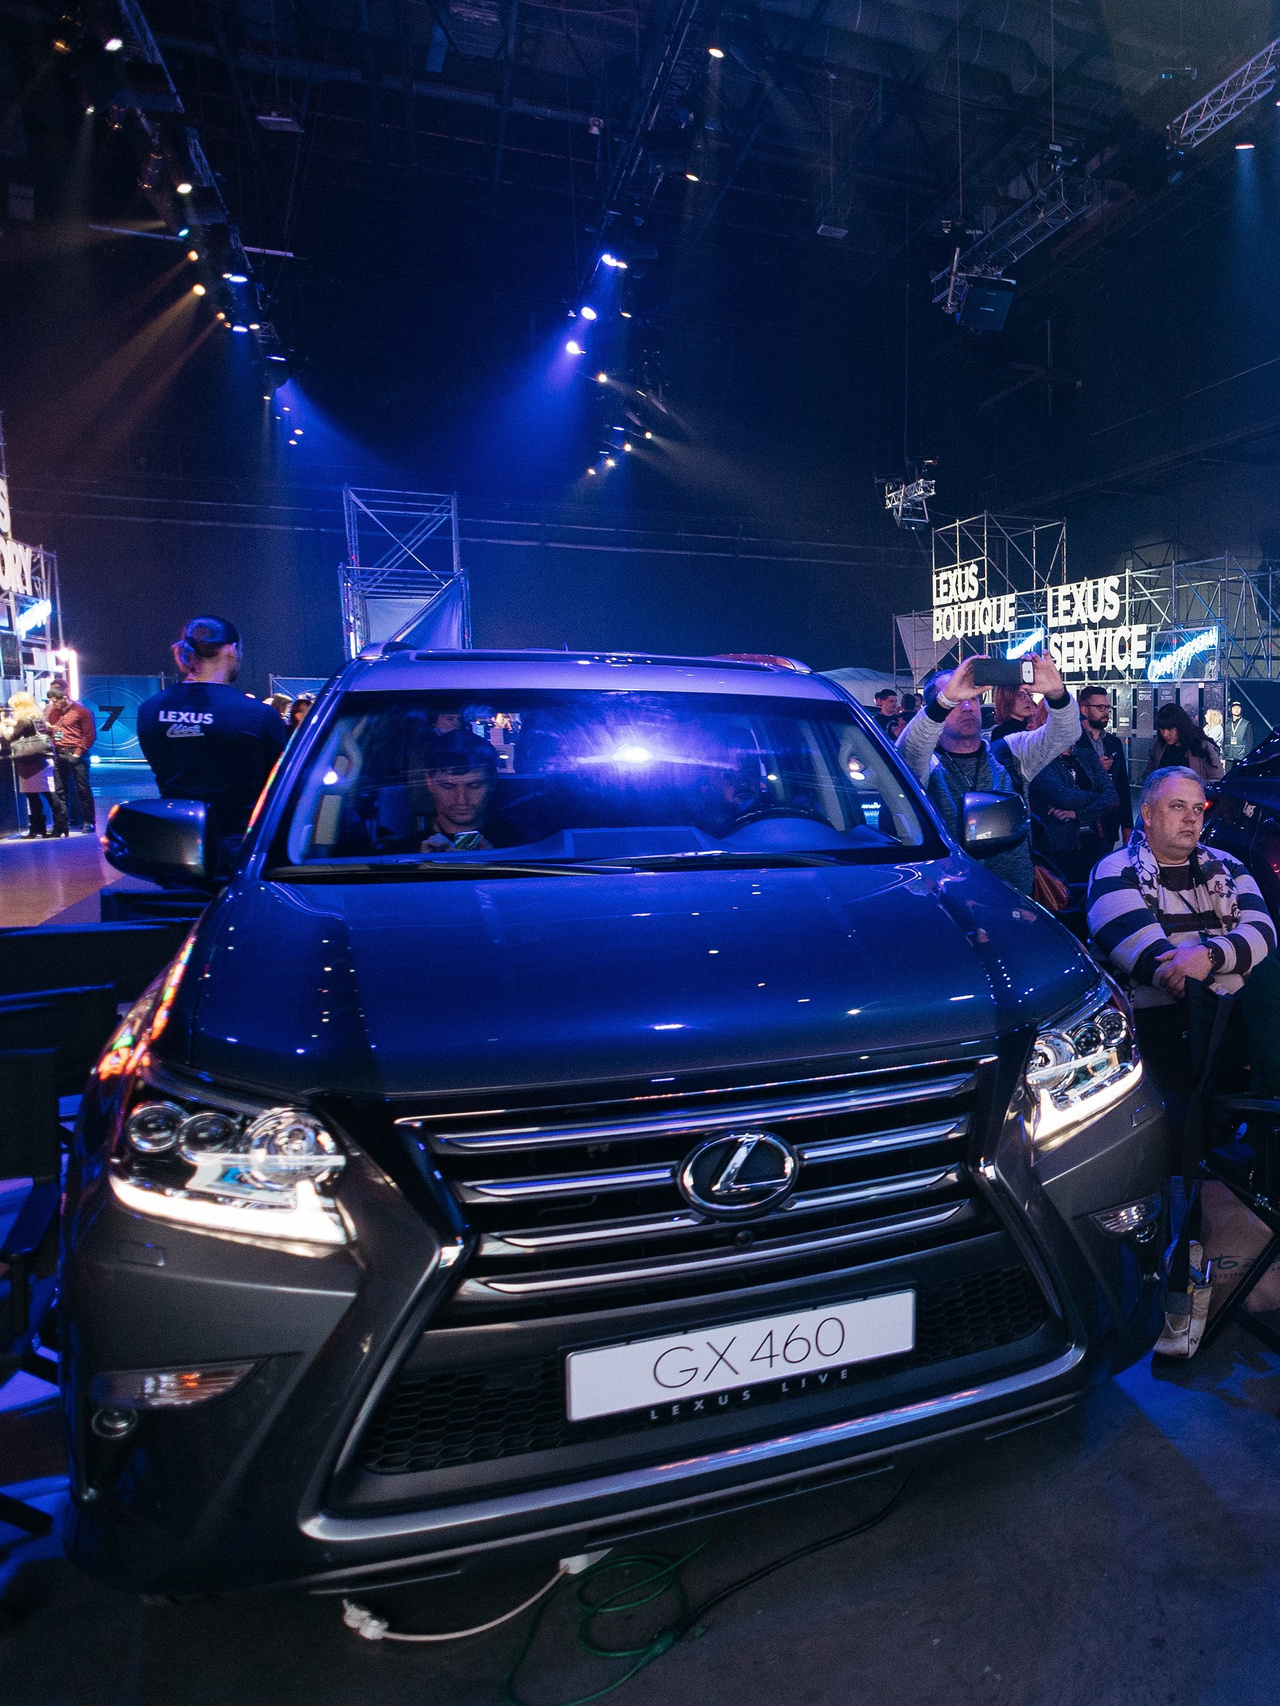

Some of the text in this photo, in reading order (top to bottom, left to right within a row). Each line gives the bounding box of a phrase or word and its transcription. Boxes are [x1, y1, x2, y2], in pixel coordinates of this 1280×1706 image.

[932, 563, 979, 606] LEXUS
[1047, 575, 1120, 628] LEXUS
[932, 593, 1016, 642] BOUTIQUE
[1049, 623, 1147, 673] SERVICE
[159, 710, 214, 724] LEXUS
[166, 723, 205, 738] Live
[652, 1316, 846, 1389] GX 460
[650, 1368, 849, 1420] LEXUS LIVE
